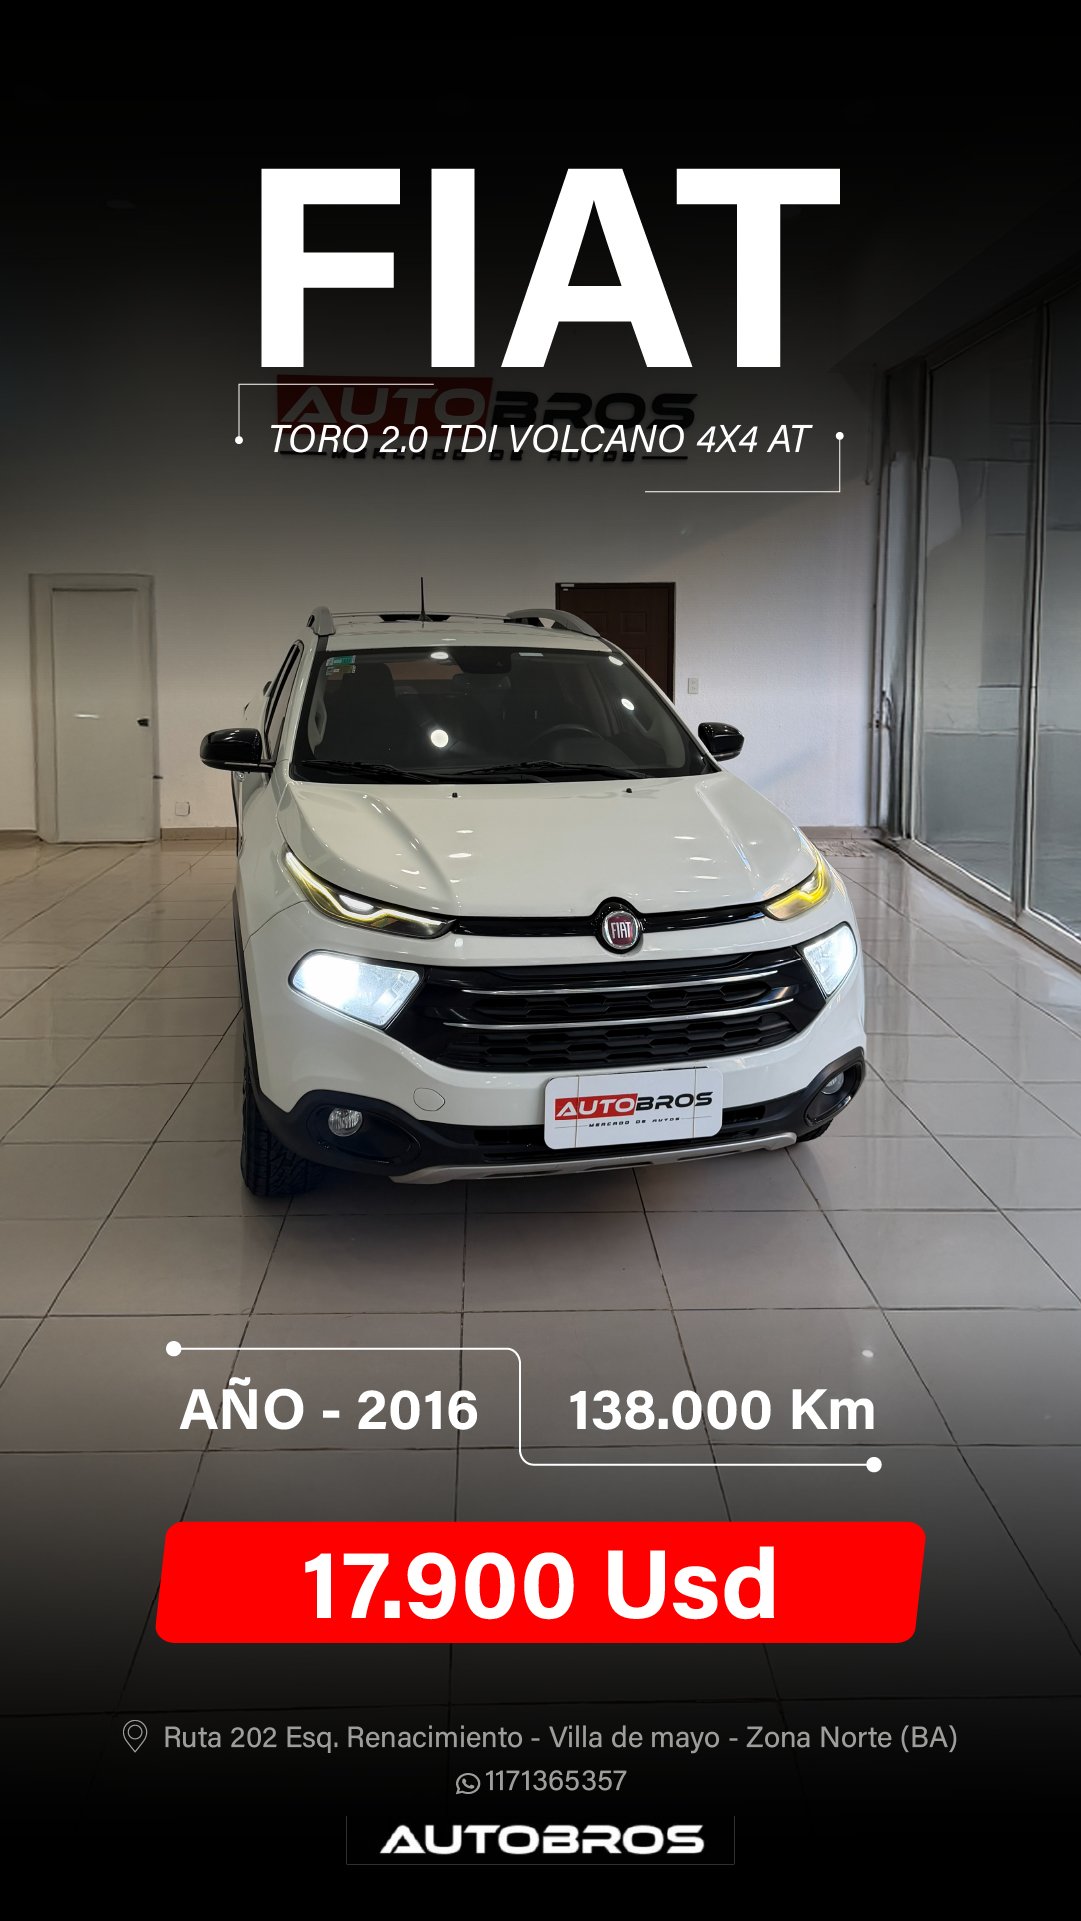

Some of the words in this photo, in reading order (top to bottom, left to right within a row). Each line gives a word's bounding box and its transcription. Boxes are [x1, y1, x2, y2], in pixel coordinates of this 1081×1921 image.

[280, 385, 698, 429] AUTOBROS
[610, 921, 632, 939] FIAT
[556, 1091, 714, 1118] AUTOBROS
